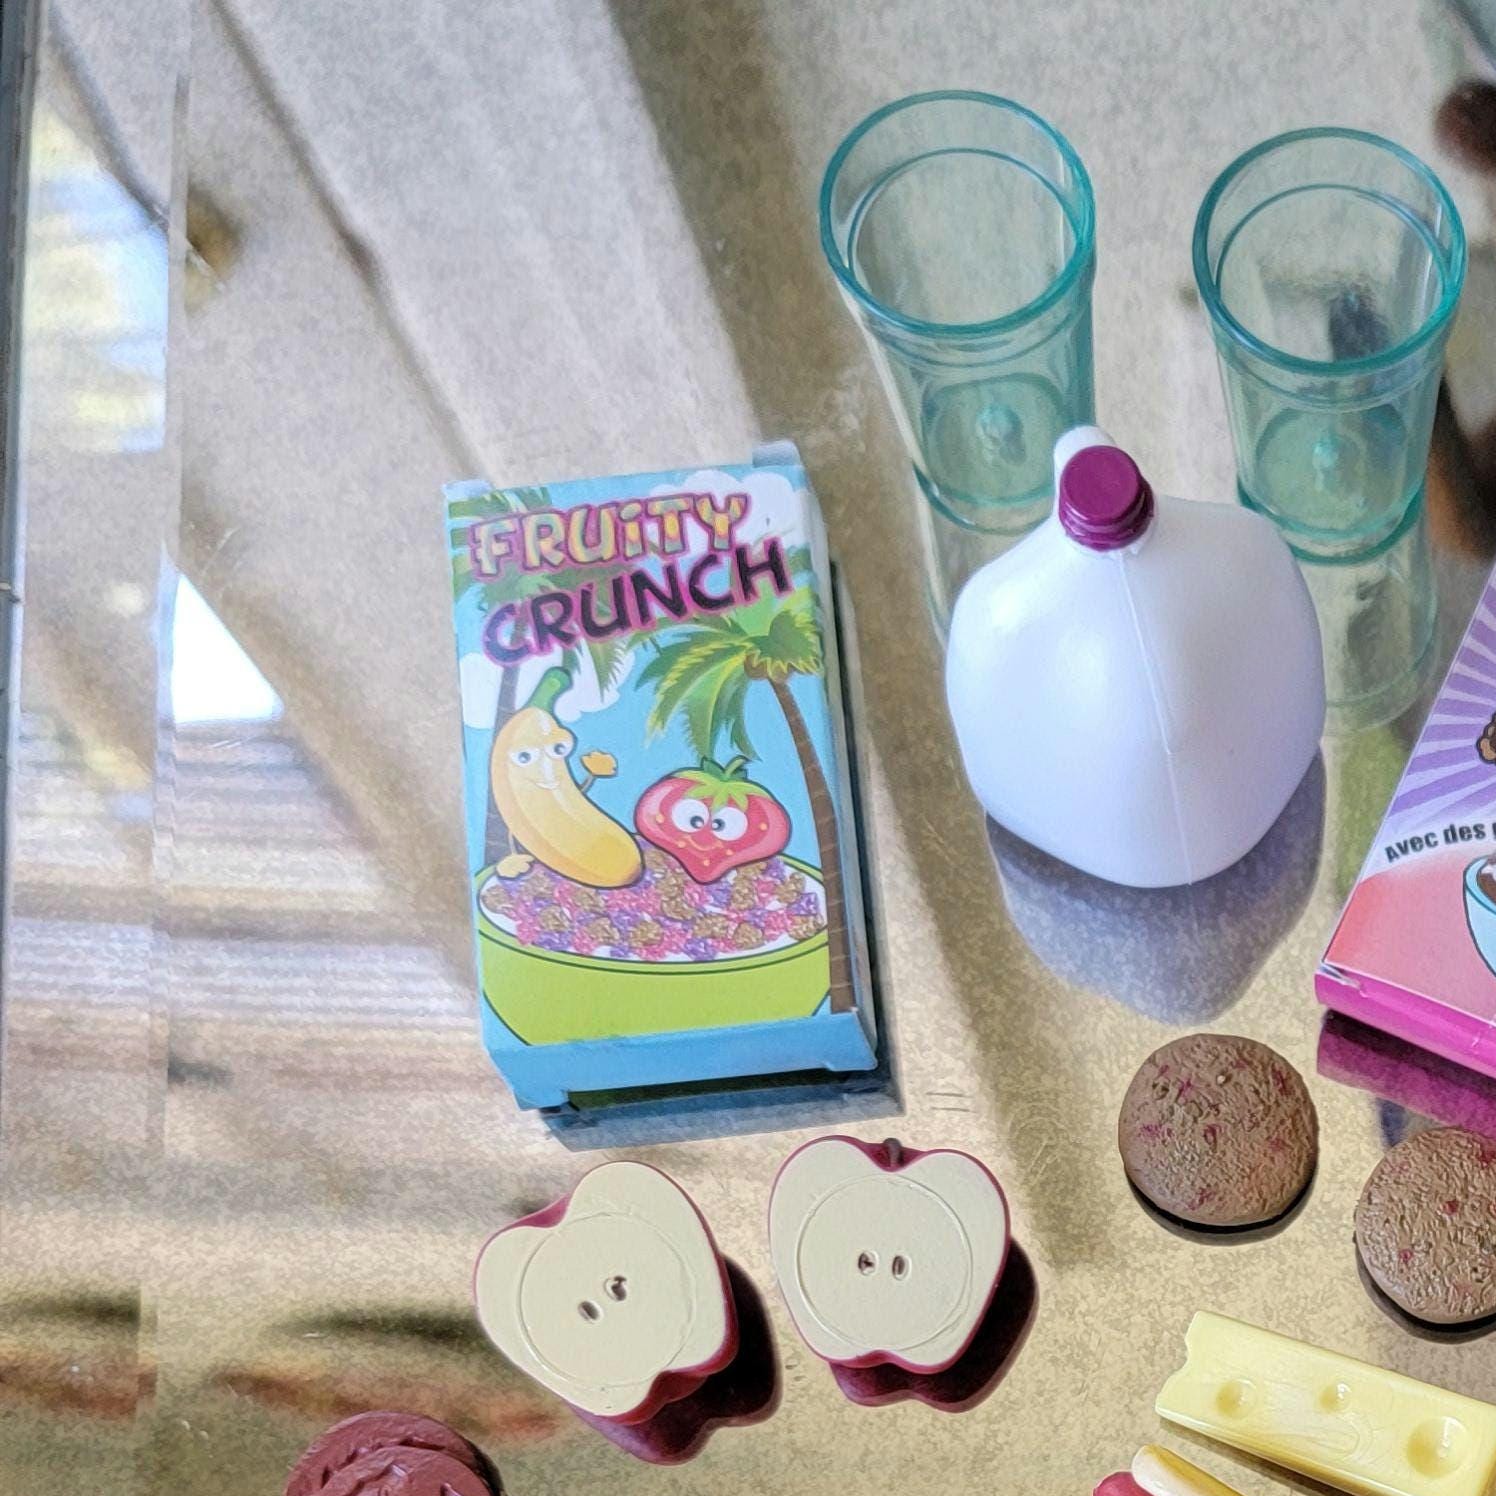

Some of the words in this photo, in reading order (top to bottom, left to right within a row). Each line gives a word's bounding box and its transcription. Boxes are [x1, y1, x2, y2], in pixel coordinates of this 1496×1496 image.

[483, 537, 791, 662] CRUNCH
[1385, 827, 1438, 862] Avec
[1443, 820, 1486, 843] des
